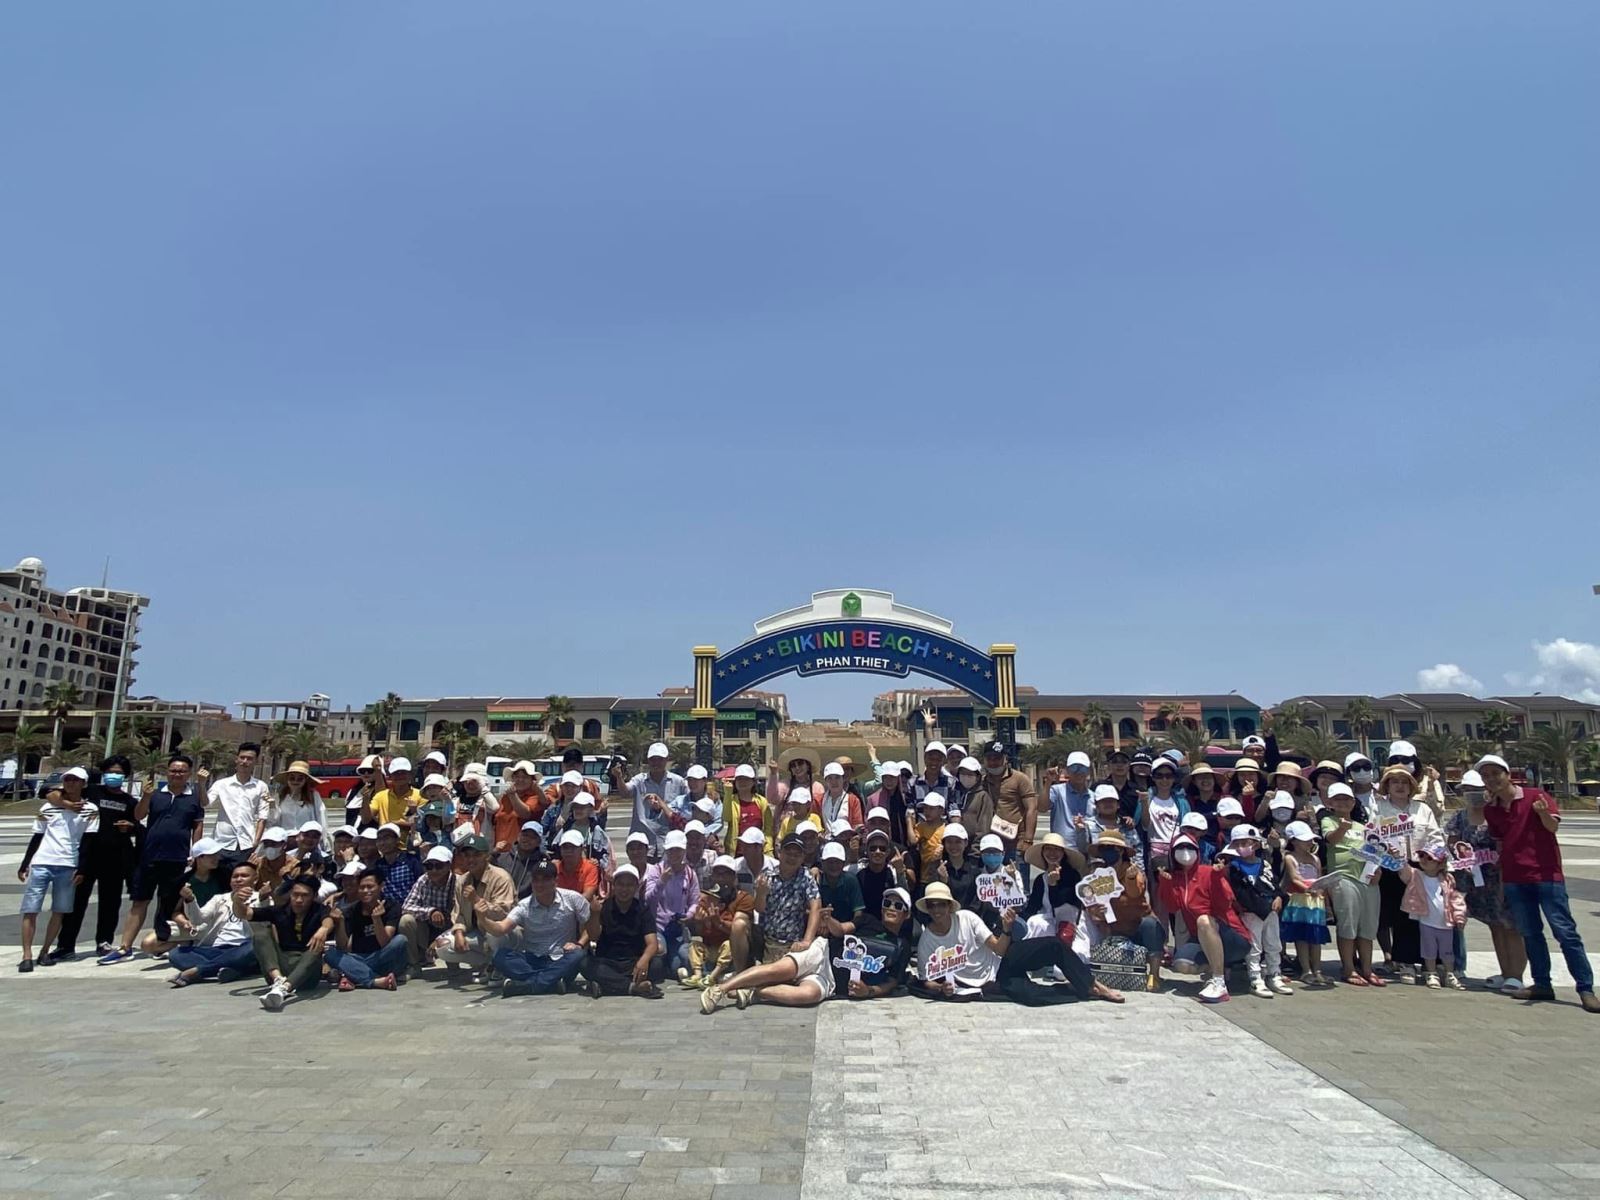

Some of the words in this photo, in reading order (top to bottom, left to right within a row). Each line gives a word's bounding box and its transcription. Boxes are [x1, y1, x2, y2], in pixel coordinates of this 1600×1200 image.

[776, 630, 845, 657] BIKINI
[852, 630, 930, 658] BEACH
[816, 656, 851, 669] PHAN
[853, 656, 890, 669] THIET
[980, 885, 998, 900] Gái
[992, 896, 1024, 909] Ngoan
